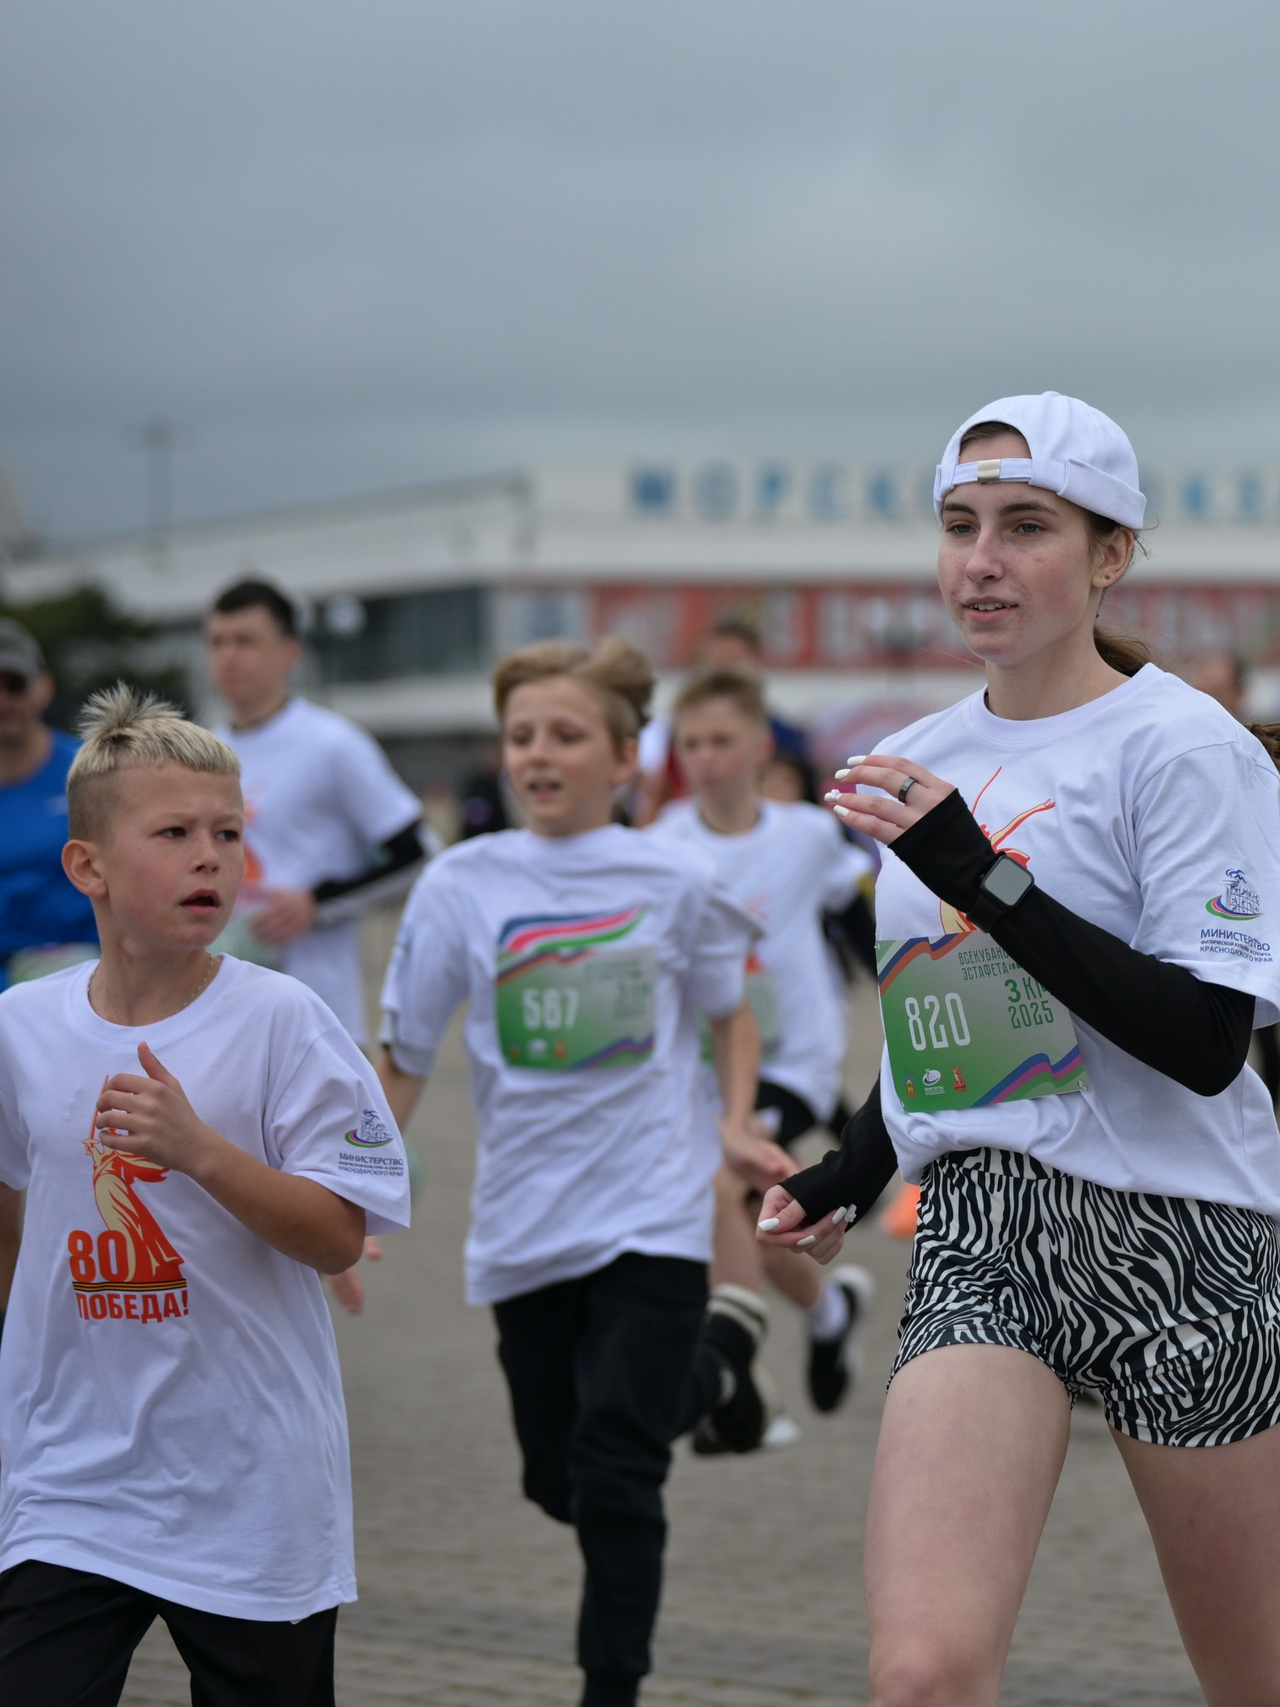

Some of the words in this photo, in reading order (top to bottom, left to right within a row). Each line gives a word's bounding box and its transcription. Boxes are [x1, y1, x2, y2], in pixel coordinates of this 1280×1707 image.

[961, 962, 1010, 981] ЭСТАФЕТА
[1004, 978, 1022, 1003] 3
[905, 993, 971, 1051] 820
[1009, 1000, 1054, 1029] 2025
[338, 1152, 404, 1166] МИНИСТЕРСТВО
[68, 1229, 129, 1283] 80
[76, 1290, 189, 1324] ПОБЕДА!
